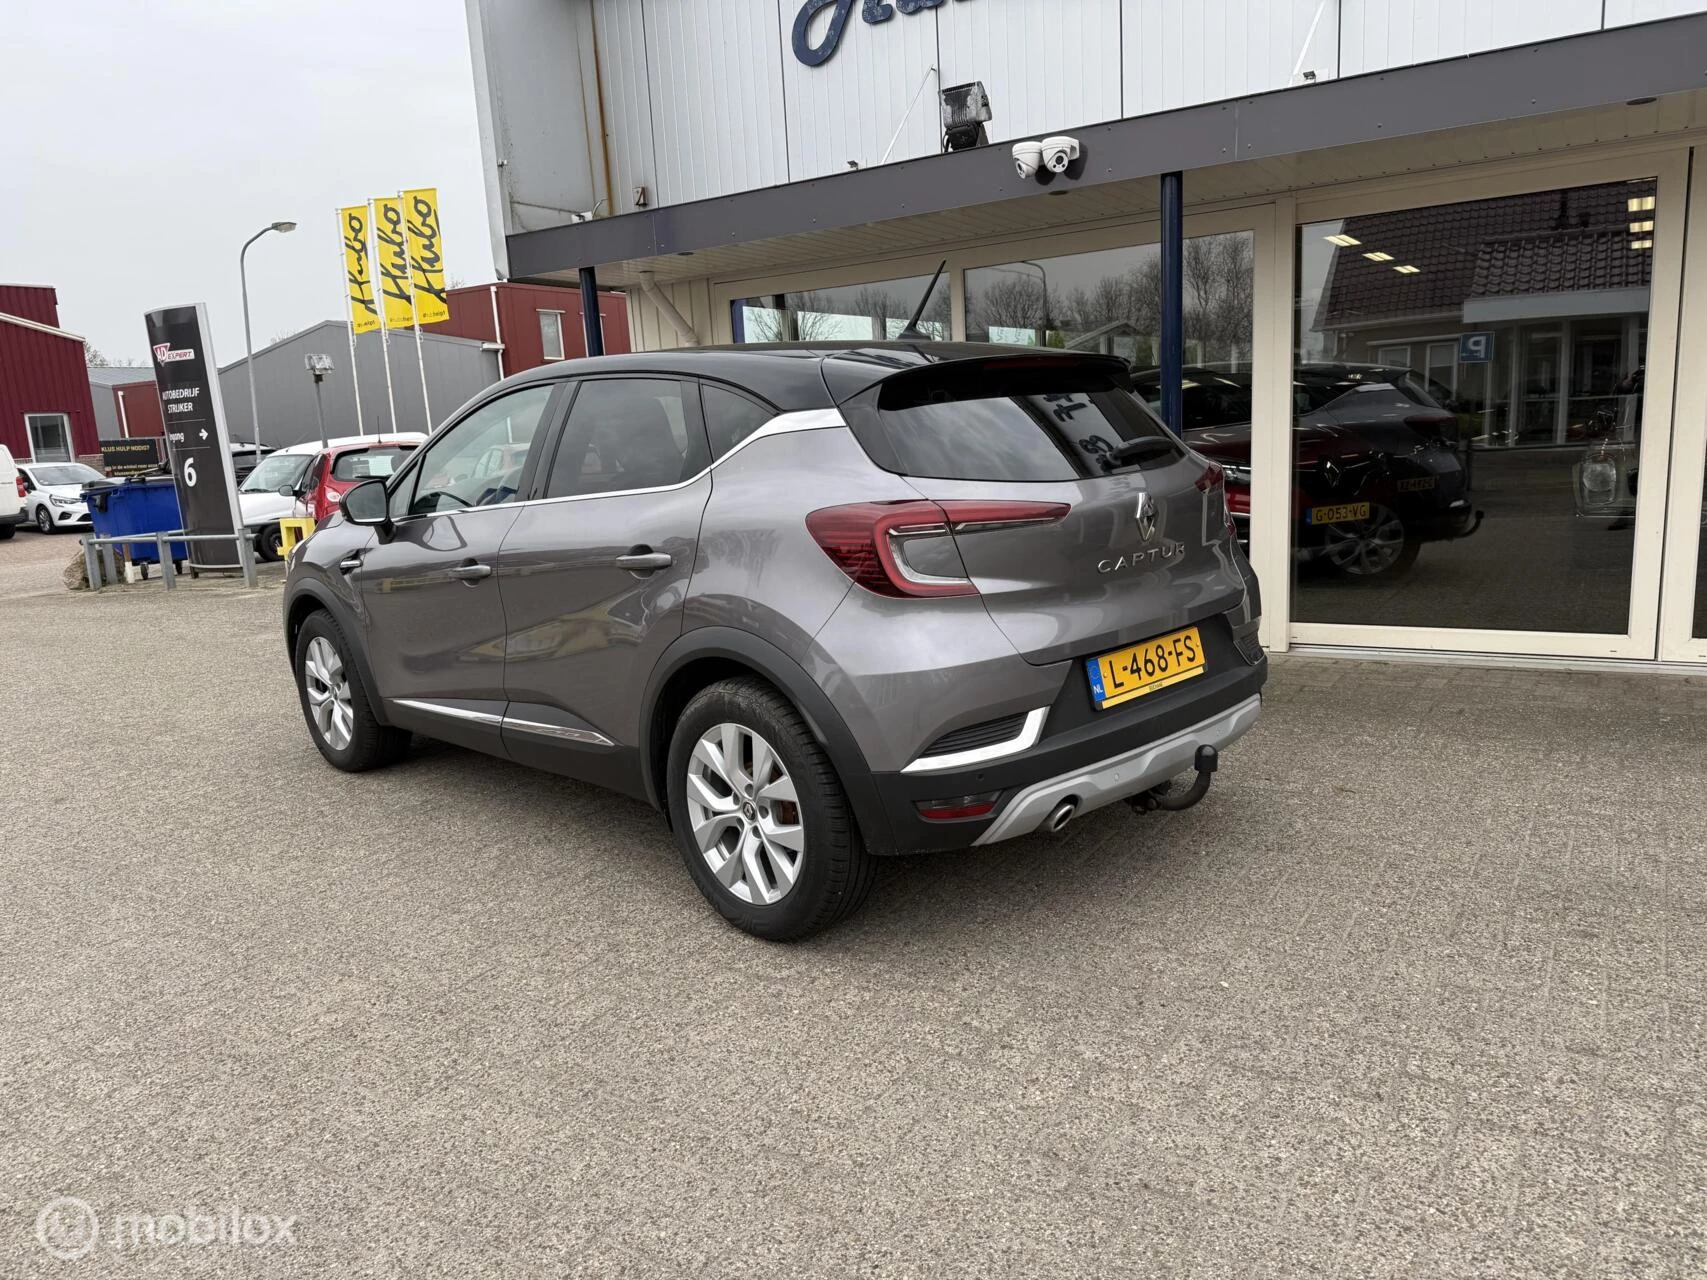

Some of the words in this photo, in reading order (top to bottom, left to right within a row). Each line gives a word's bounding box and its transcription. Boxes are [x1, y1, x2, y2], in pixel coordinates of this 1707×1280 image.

[183, 457, 197, 487] 6
[1097, 542, 1185, 573] CAPTUR
[1108, 635, 1196, 689] L-468-FS
[1093, 685, 1104, 694] NL
